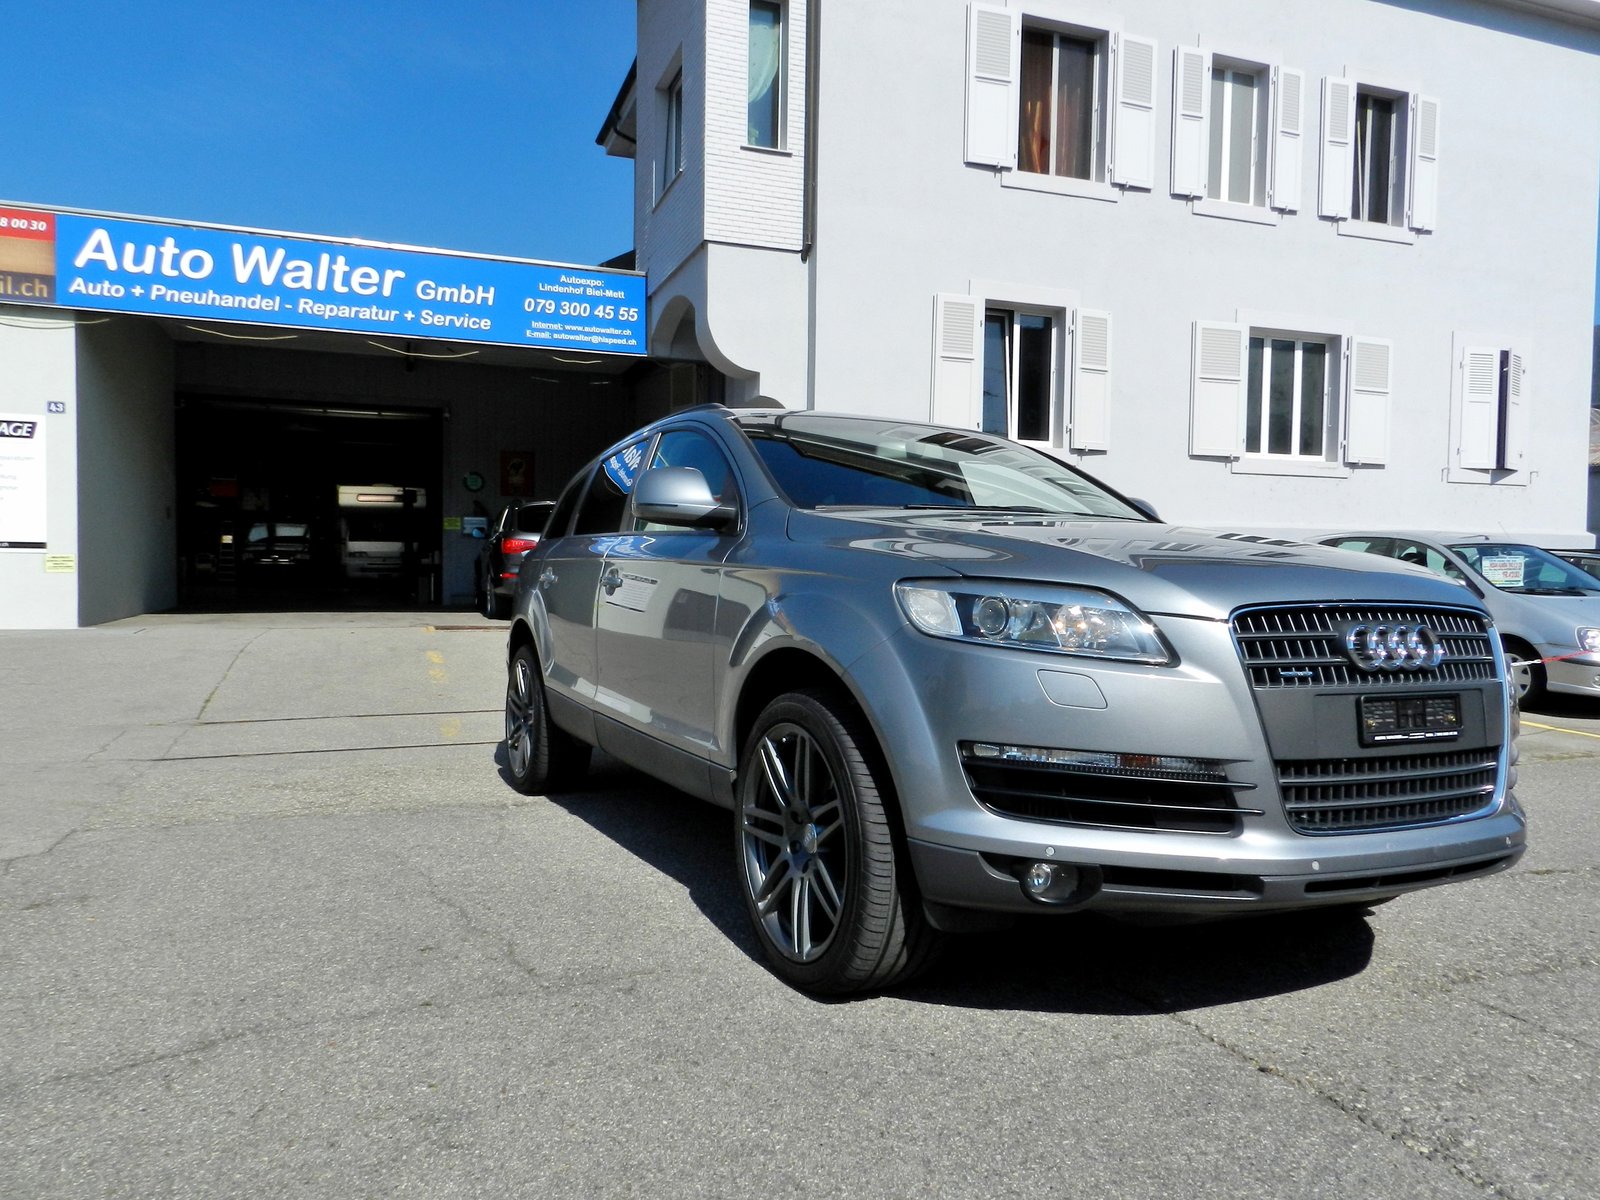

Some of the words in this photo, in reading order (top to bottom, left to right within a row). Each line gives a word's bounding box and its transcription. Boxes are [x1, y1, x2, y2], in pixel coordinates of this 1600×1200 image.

[11, 218, 28, 230] 00
[29, 220, 48, 232] 30
[74, 228, 215, 280] Auto
[232, 243, 406, 298] Walter
[415, 279, 496, 306] GmbH
[560, 274, 605, 287] Autoexpo:
[538, 282, 585, 295] Lindenhof
[586, 286, 625, 299] Biel-Mett
[69, 277, 126, 298] Auto
[131, 283, 145, 297] +
[150, 284, 281, 312] Pneuhandel
[298, 299, 399, 322] Reparatur
[403, 308, 416, 322] +
[420, 309, 492, 331] Service
[524, 297, 556, 314] 079
[560, 301, 591, 317] 300
[594, 304, 615, 319] 45
[618, 307, 639, 321] 55
[526, 330, 552, 340] E-mail:
[531, 321, 563, 331] Internet:
[564, 325, 632, 336] www.autowalter.ch
[49, 402, 64, 412] 43
